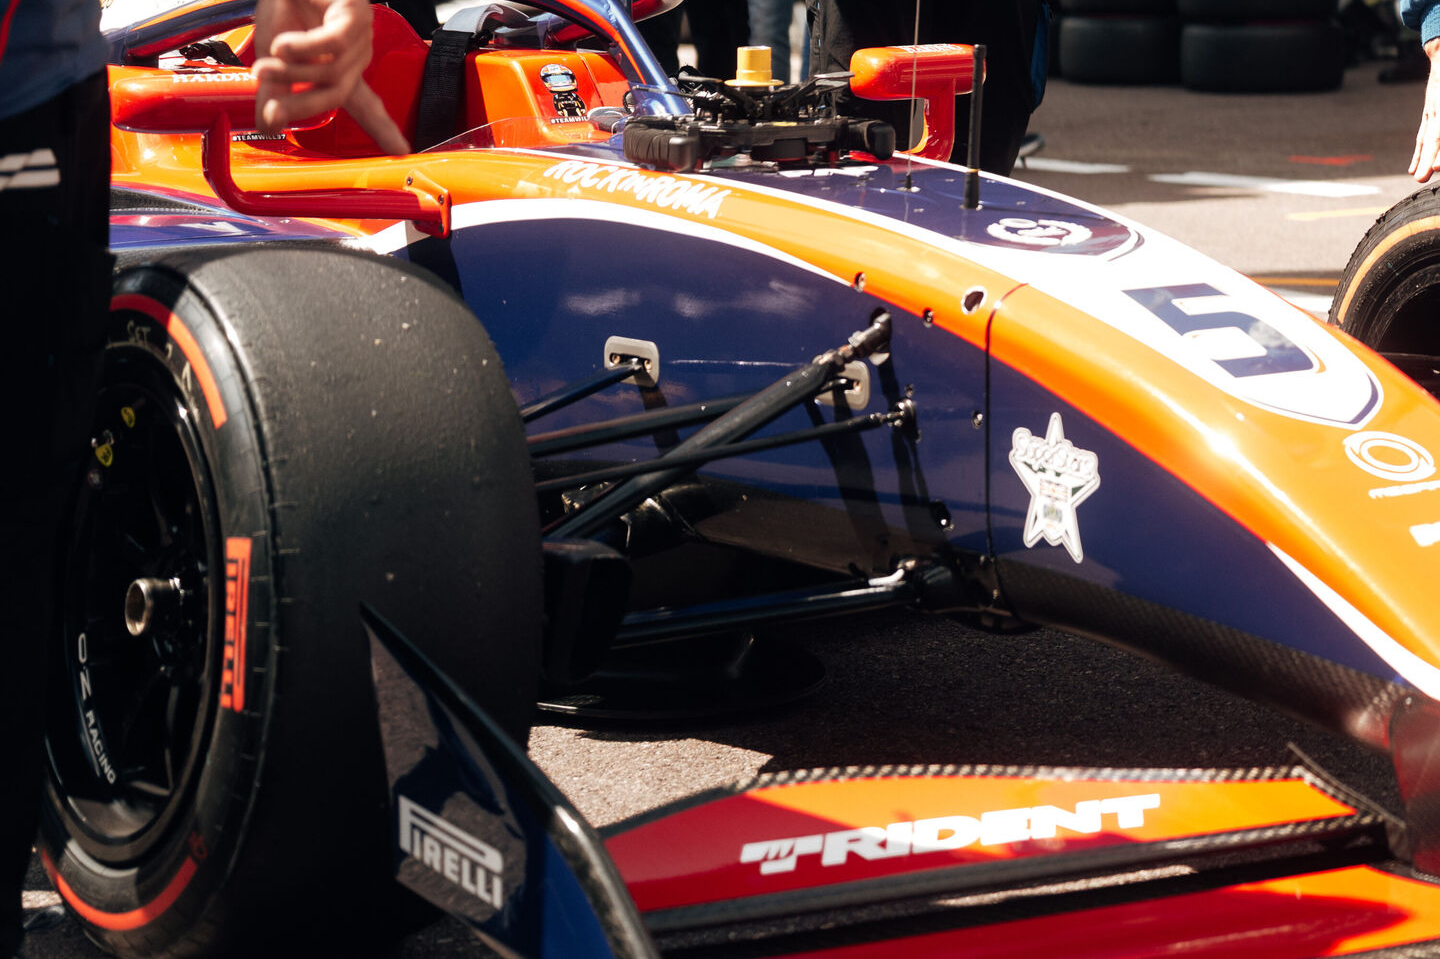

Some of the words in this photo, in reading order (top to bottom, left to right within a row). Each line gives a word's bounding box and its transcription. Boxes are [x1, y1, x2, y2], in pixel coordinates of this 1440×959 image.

[1121, 282, 1314, 379] 5
[220, 537, 253, 713] PIRELLI
[77, 632, 93, 701] OZ
[85, 710, 118, 785] RACING
[397, 793, 505, 912] PIRELLI
[740, 793, 1162, 876] TRIDENT
